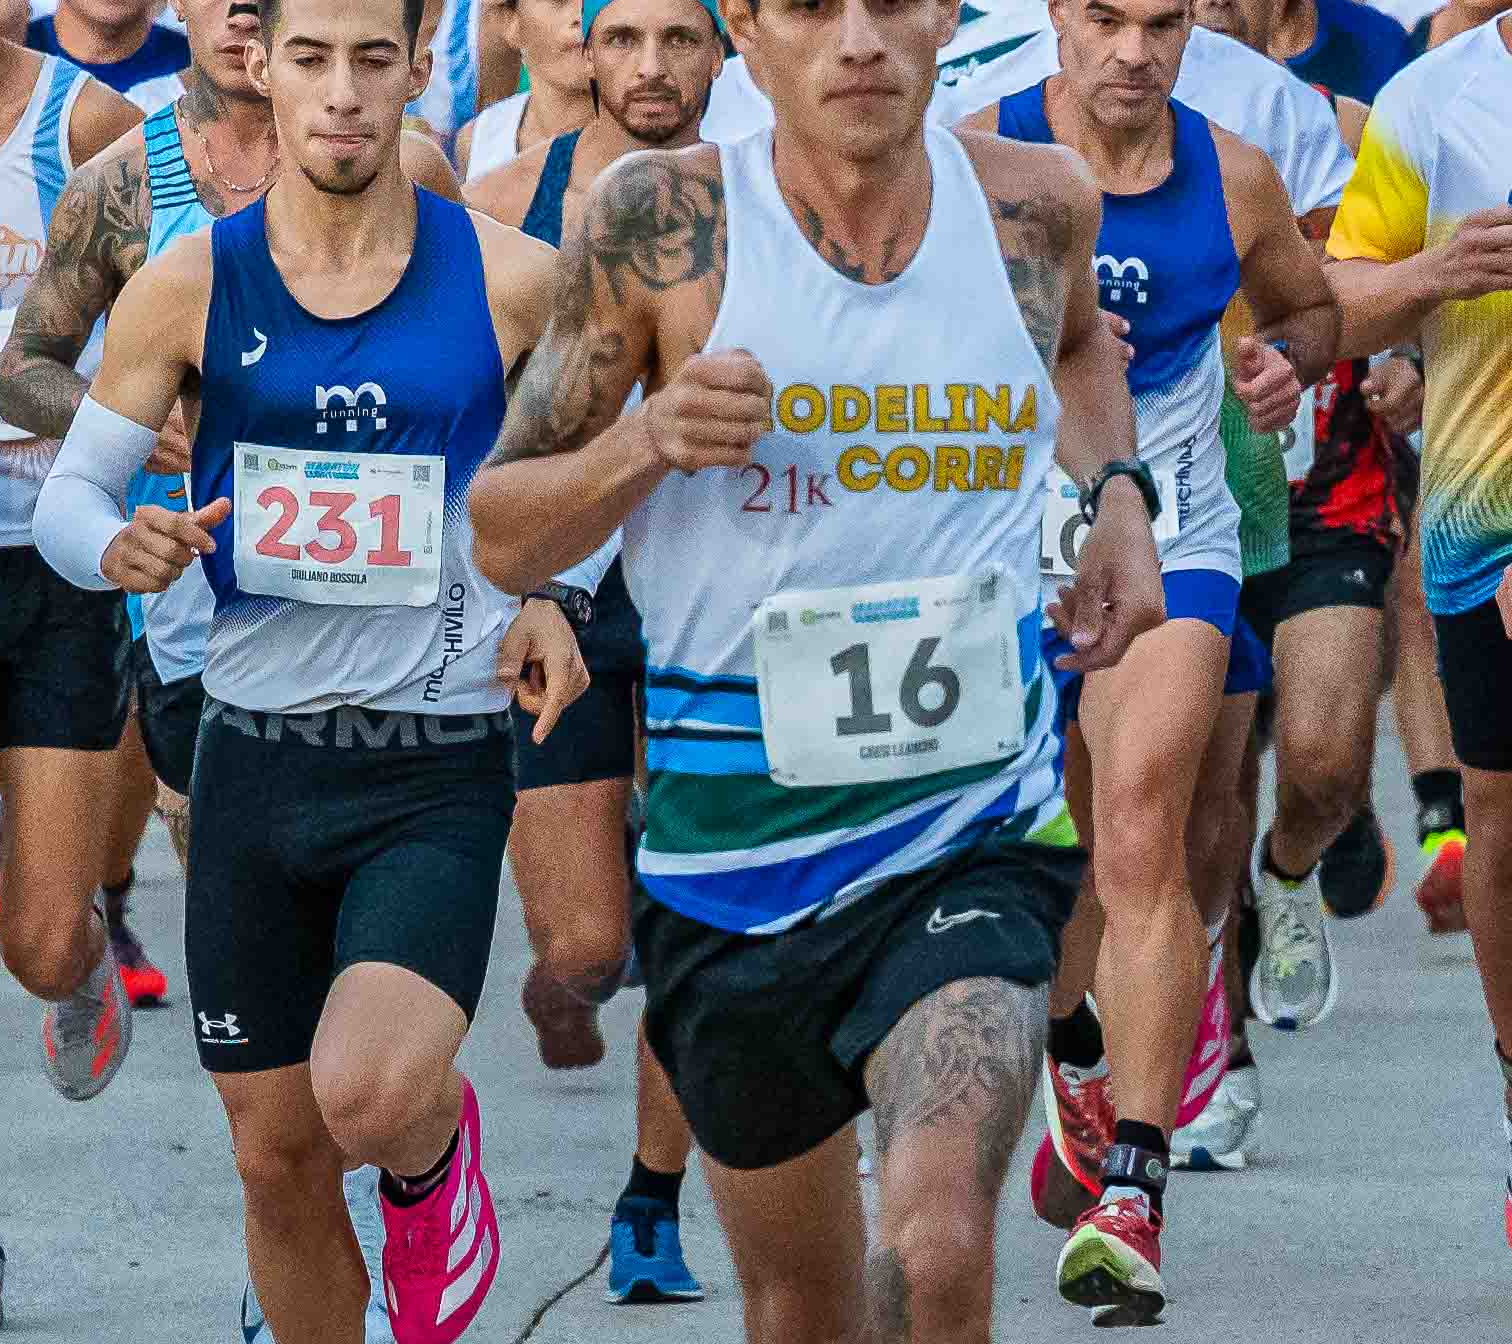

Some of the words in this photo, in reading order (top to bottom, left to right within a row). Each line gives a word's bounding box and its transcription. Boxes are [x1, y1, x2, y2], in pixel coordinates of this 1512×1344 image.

[322, 406, 378, 419] running
[761, 382, 1038, 434] ODELINA
[255, 485, 413, 567] 231
[829, 636, 961, 737] 16
